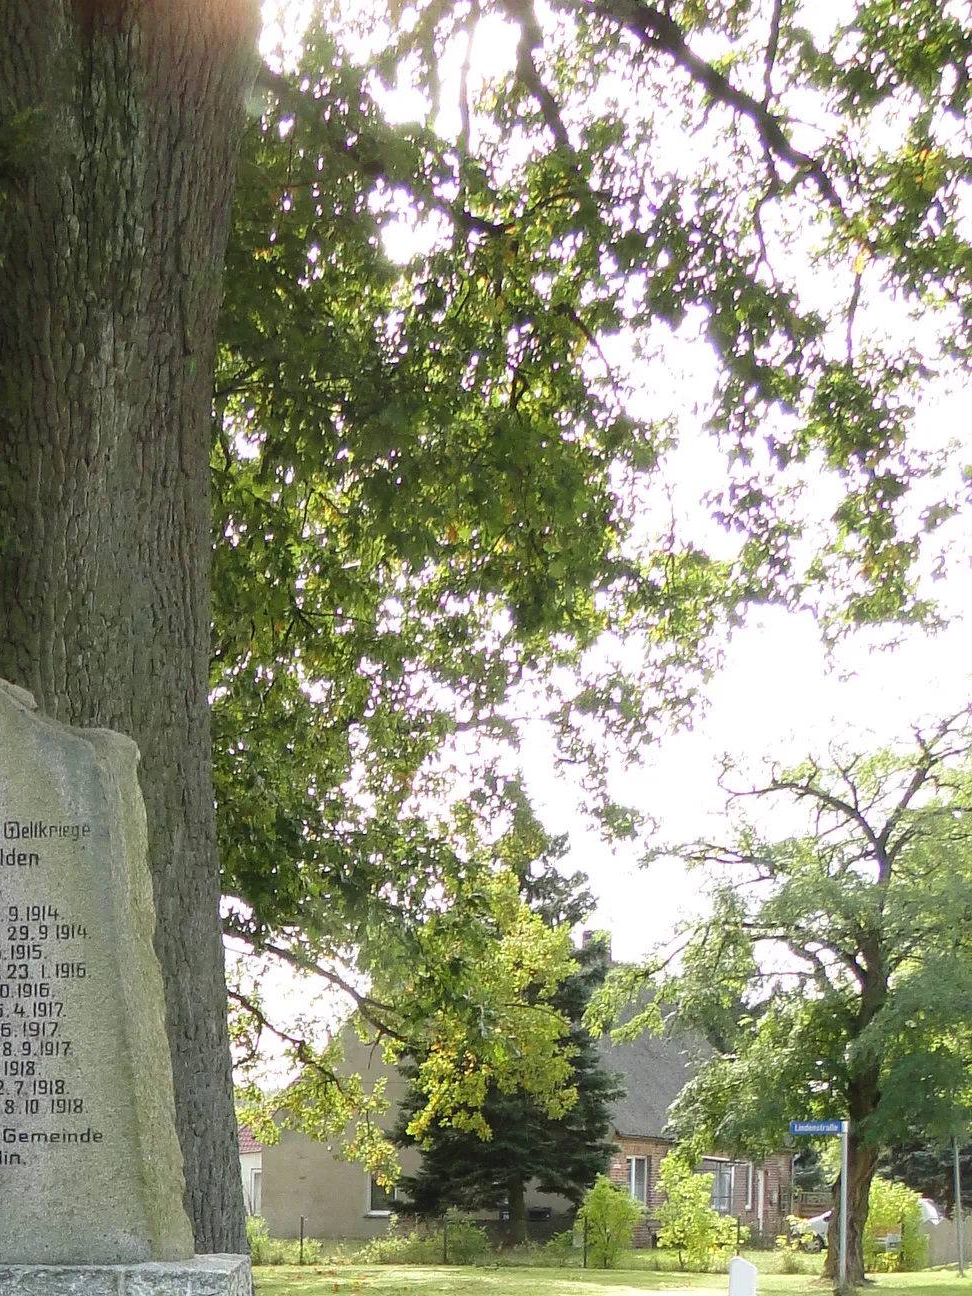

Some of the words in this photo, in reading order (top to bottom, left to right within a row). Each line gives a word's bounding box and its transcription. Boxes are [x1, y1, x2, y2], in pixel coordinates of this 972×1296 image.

[4, 821, 91, 841] Weltkriege
[794, 1122, 839, 1131] Lindenstraße
[3, 1127, 103, 1143] Gemeinde
